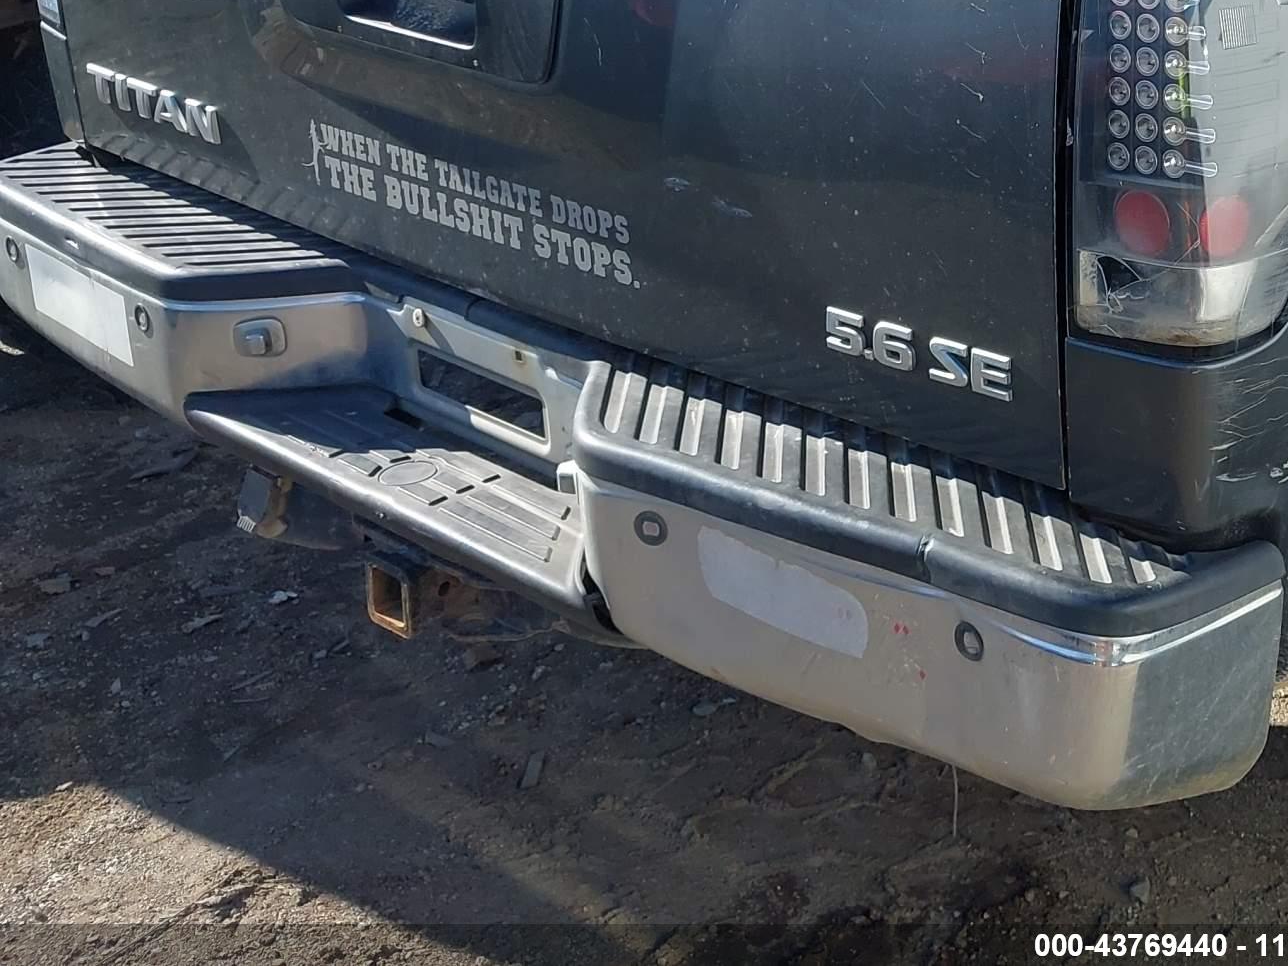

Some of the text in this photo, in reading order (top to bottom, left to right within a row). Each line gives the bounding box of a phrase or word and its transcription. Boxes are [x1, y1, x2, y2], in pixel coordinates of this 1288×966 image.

[86, 63, 221, 144] TITAN
[320, 123, 630, 244] WHEN THE TAILGATE DROPS
[324, 155, 641, 289] THE BULLSHIT STOPS.
[826, 306, 1013, 402] 5.6 SE
